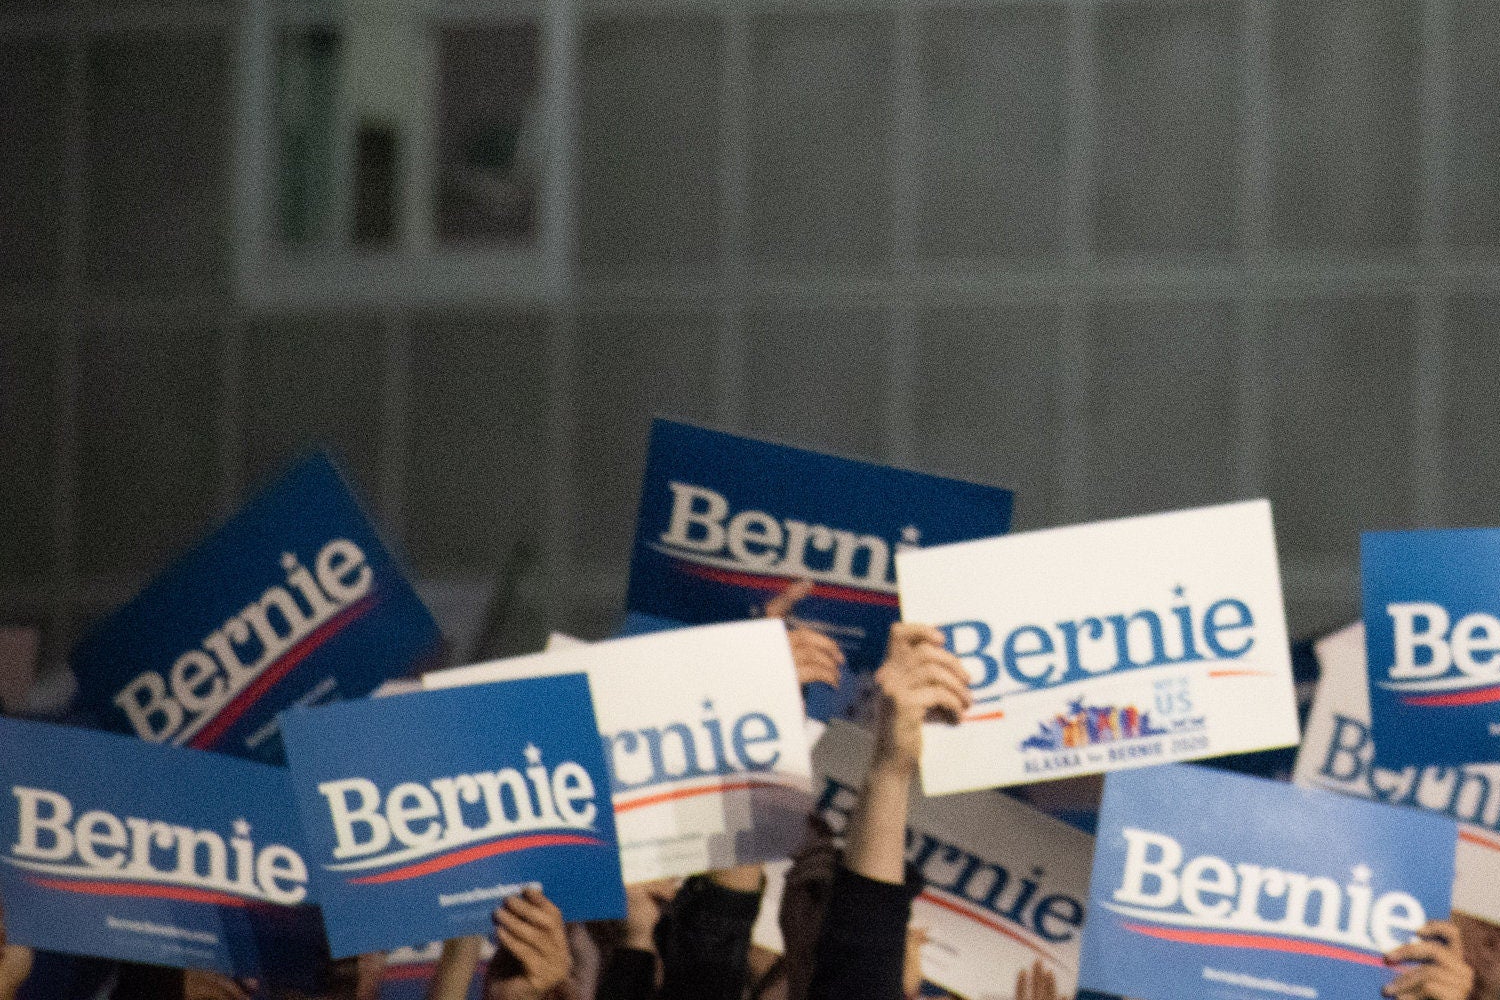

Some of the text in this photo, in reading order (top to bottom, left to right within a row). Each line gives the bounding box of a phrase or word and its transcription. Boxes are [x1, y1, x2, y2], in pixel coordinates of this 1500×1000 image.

[659, 480, 921, 595] Bern
[113, 537, 373, 743] Bernie
[937, 583, 1256, 690] Bernie
[318, 743, 597, 859] Bernie
[599, 695, 781, 794] rnie
[1023, 754, 1081, 774] ALASKA
[1108, 742, 1163, 762] BERNIE
[11, 785, 309, 904] Bernie
[1113, 827, 1427, 954] Bernie
